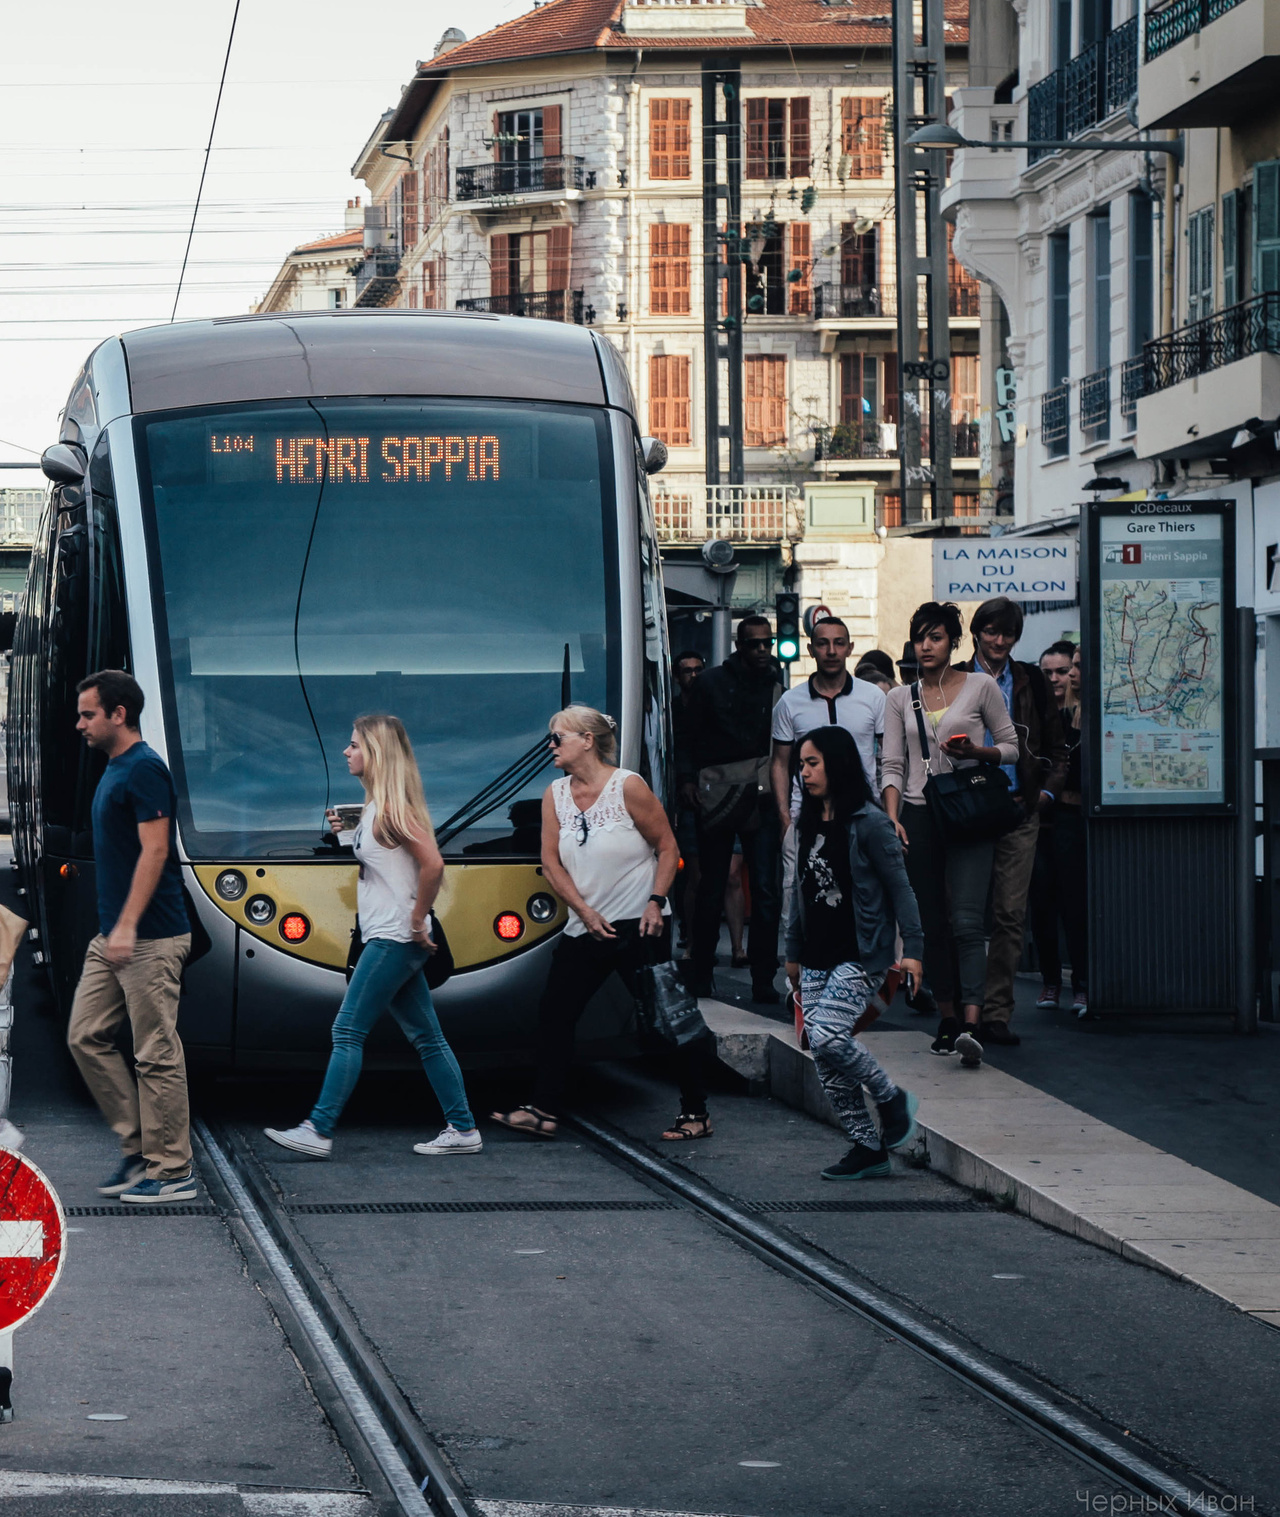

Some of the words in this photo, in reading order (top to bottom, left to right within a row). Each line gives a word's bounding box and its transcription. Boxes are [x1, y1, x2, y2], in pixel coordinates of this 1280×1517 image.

[211, 435, 254, 452] L104
[276, 437, 370, 484] HENRI
[382, 436, 500, 483] SAPPIA
[1130, 503, 1193, 515] JCDecaux
[1127, 522, 1156, 533] Gare
[1158, 521, 1196, 532] Thiers
[943, 549, 970, 560] LA
[977, 547, 1067, 559] MAISON
[1126, 546, 1135, 561] 1
[1144, 551, 1171, 561] Henri
[1173, 550, 1208, 563] Sappia
[982, 565, 1015, 576] DU
[949, 581, 1066, 594] PANTALON
